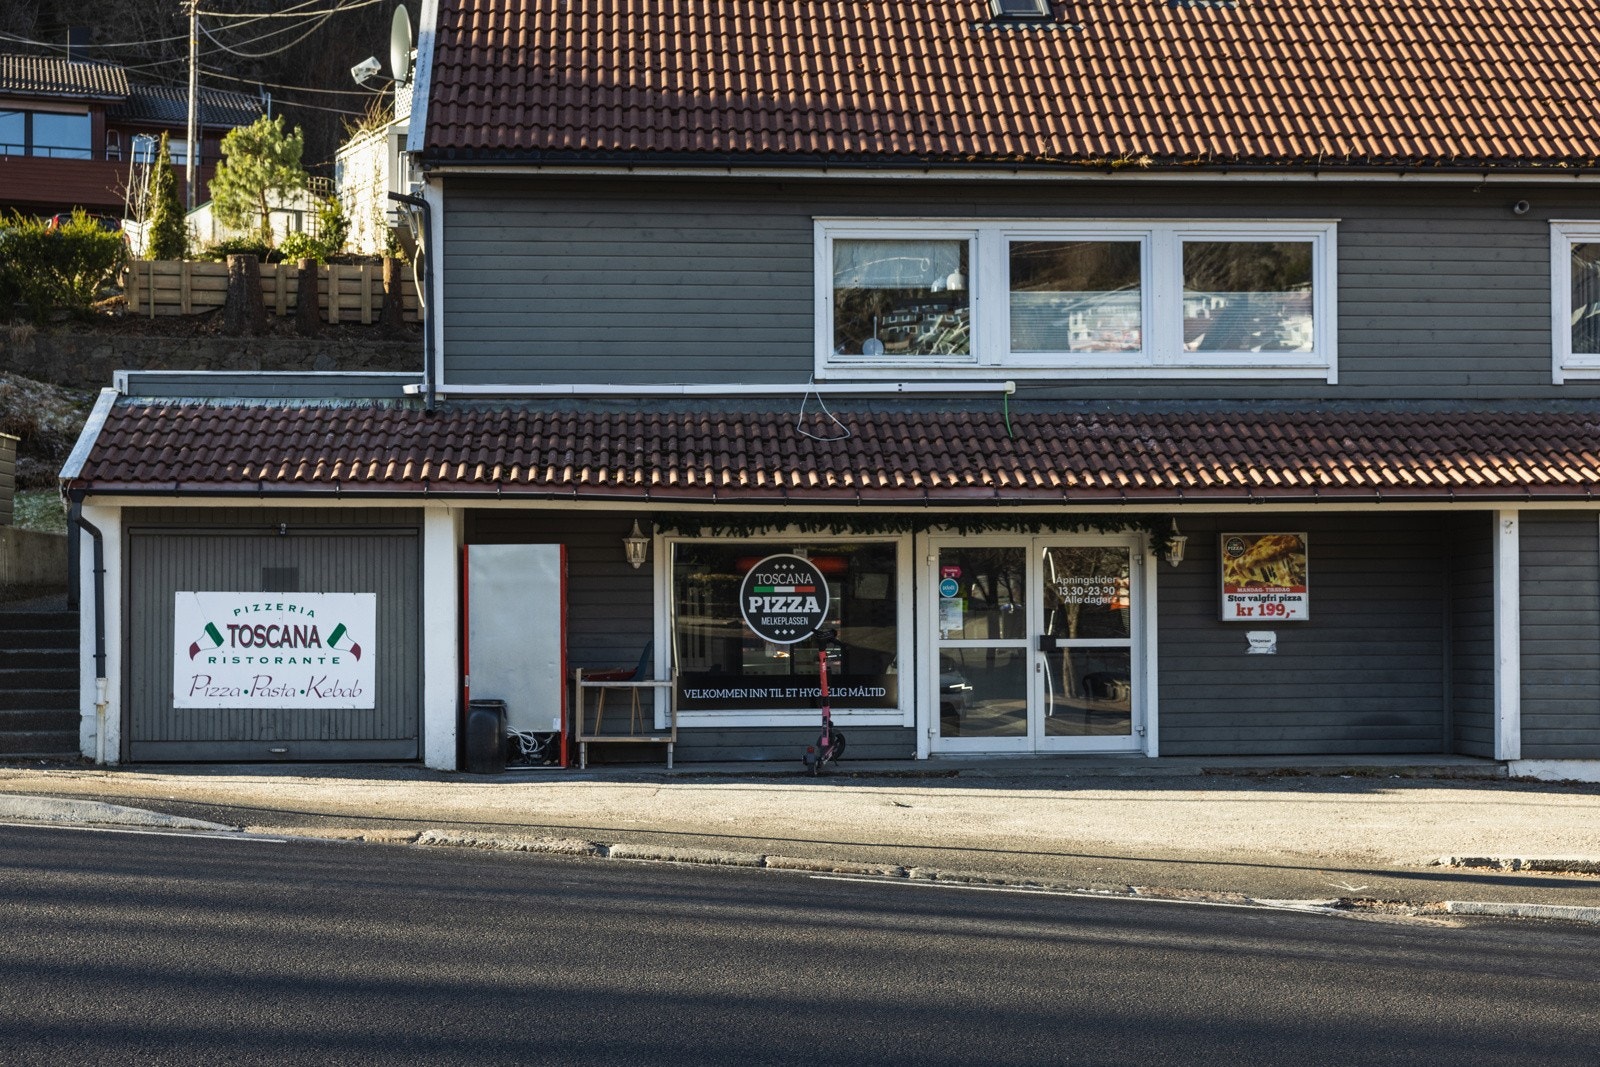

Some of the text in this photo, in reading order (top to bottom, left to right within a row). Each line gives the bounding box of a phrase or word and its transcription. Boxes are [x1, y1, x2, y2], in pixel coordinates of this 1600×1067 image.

[756, 573, 813, 585] TOSCANA
[1056, 574, 1116, 586] Åpningstider
[1059, 586, 1115, 596] 13.30-23.00
[748, 596, 821, 613] PIZZA
[1064, 596, 1112, 606] Alle dager
[1248, 594, 1277, 603] valgfri
[1279, 594, 1302, 603] pizza
[233, 603, 316, 618] PIZZERIA
[1236, 602, 1296, 619] kr 199,-
[761, 616, 809, 626] MELKEPLASSEN
[227, 623, 323, 649] TOSCANA
[208, 656, 341, 665] RISTORANTE
[189, 674, 363, 699] Pizza Pasta Kebab
[684, 685, 886, 699] VELKOMMEN INN TIL ET HYGELIG MÅLTID
